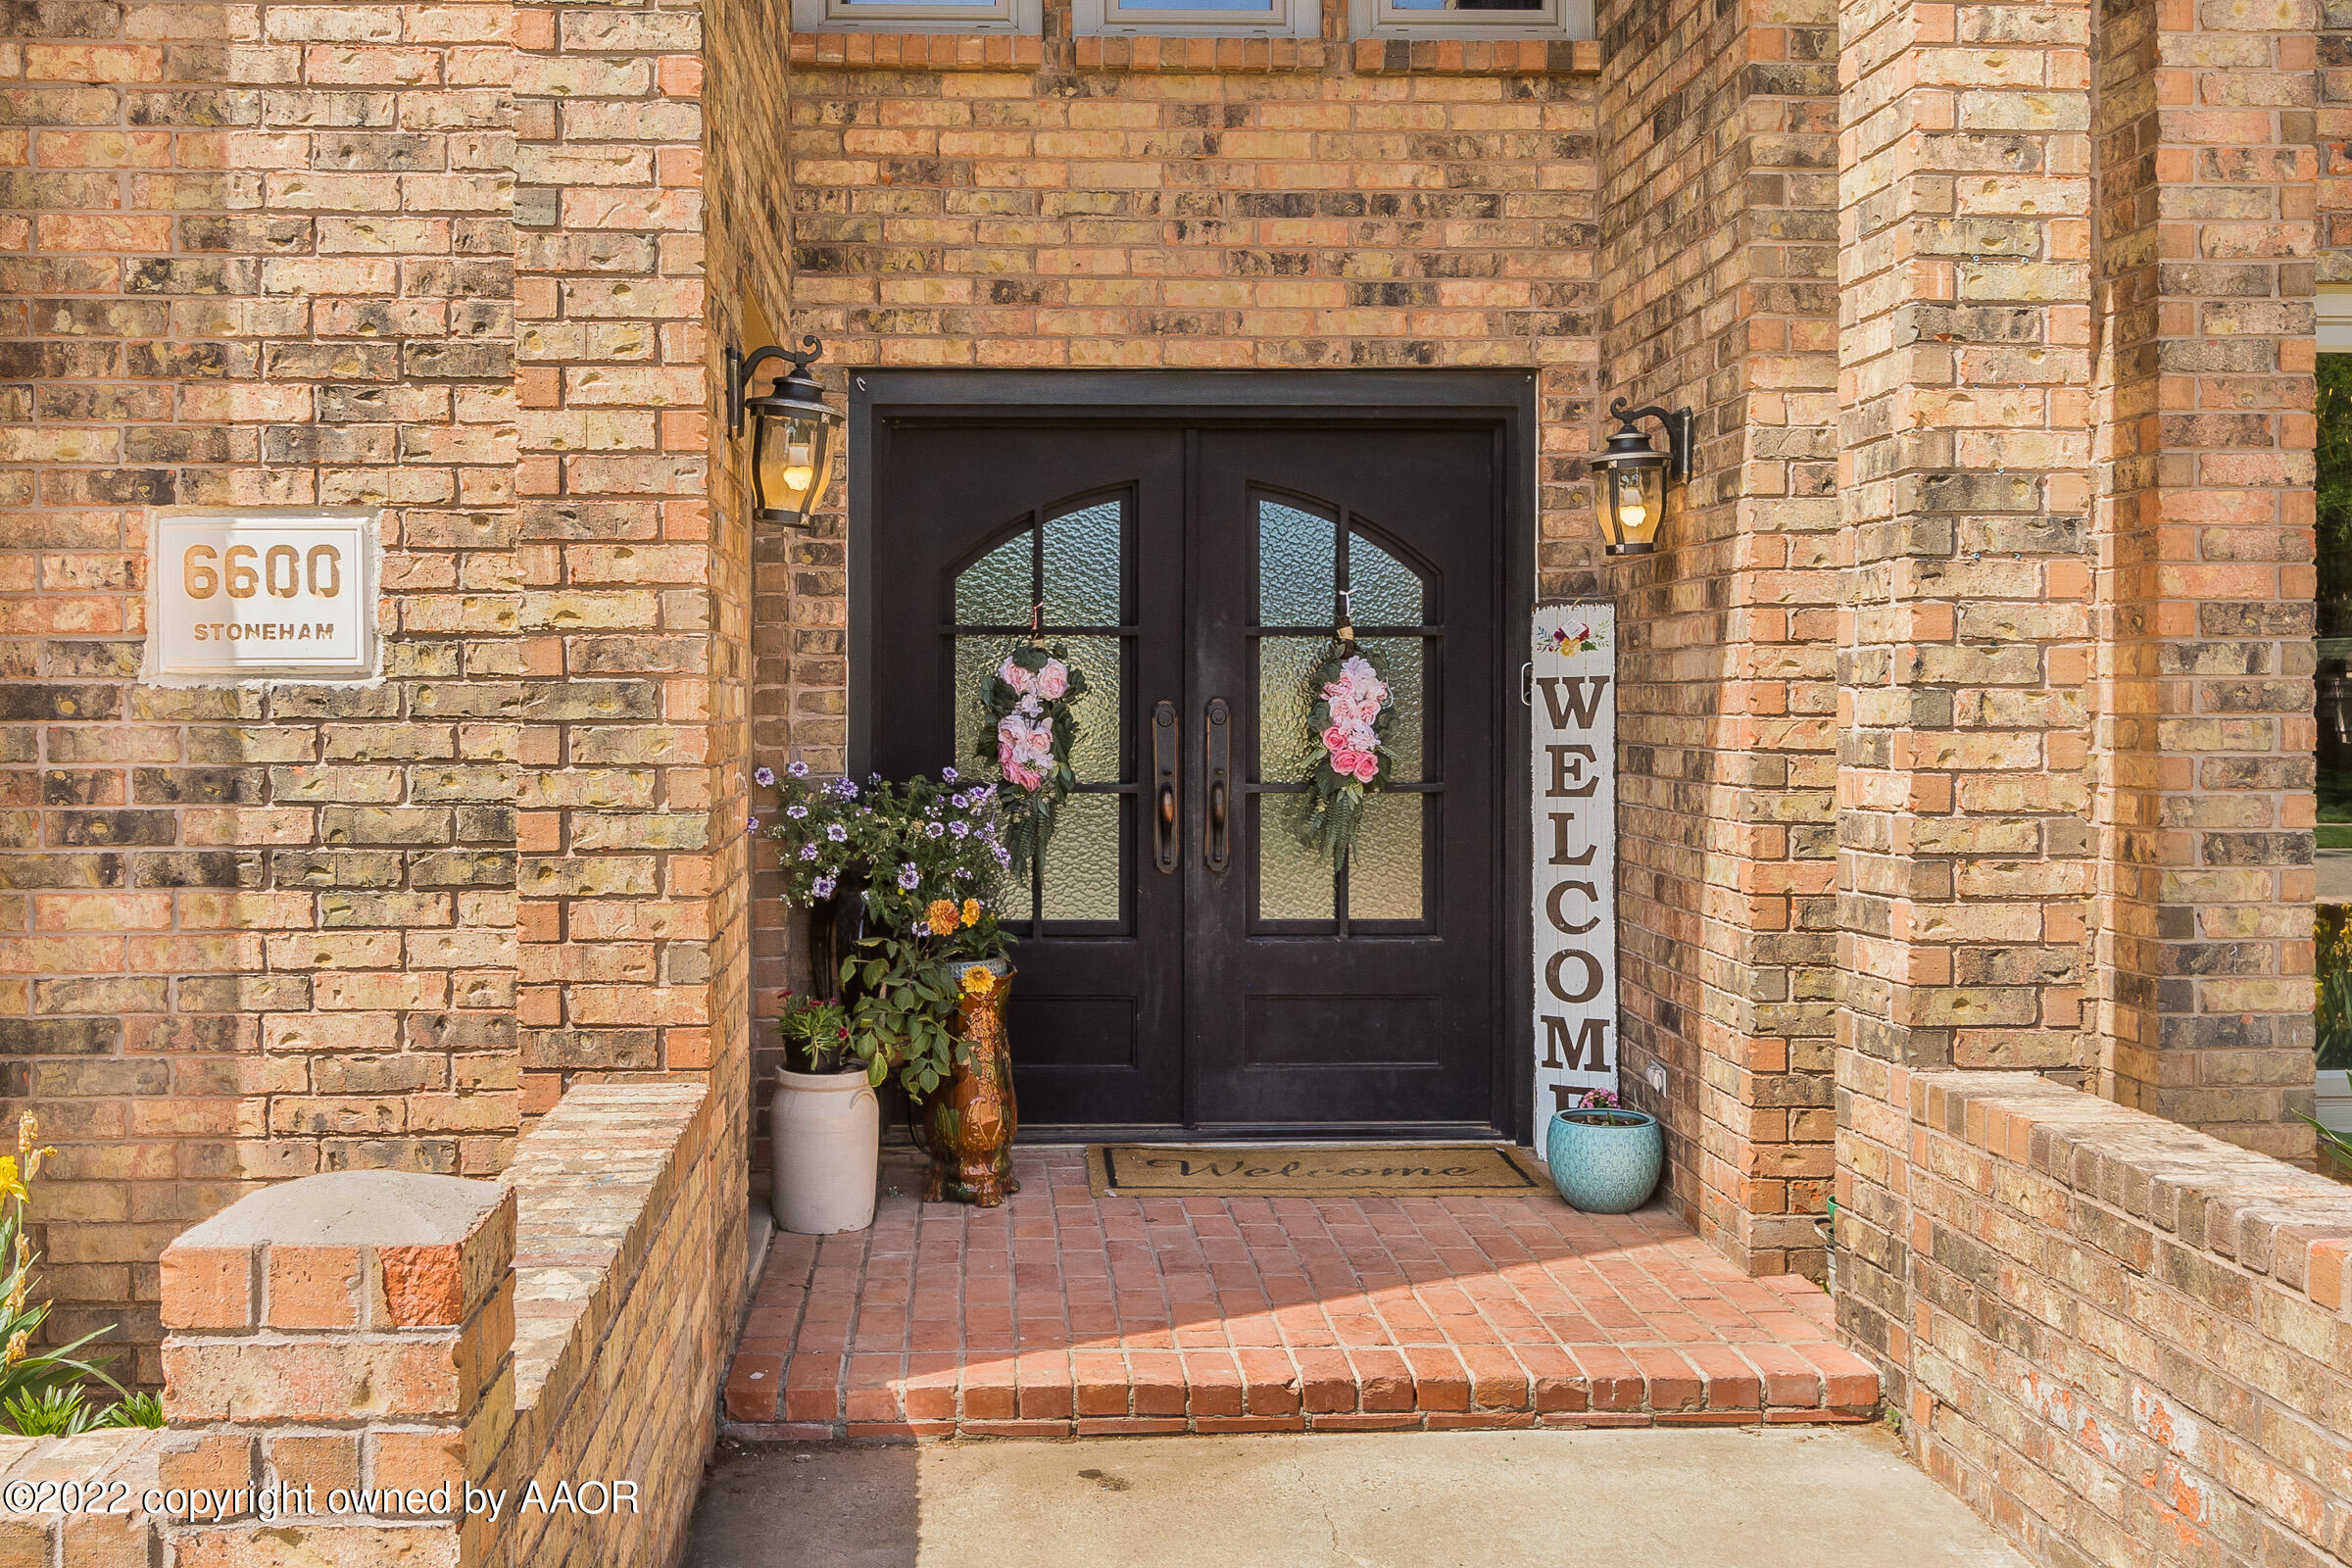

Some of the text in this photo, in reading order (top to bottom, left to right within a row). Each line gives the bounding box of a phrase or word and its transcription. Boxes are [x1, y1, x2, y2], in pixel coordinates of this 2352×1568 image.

[183, 544, 341, 600] 6600
[194, 623, 334, 641] STONEHAM
[1147, 1158, 1481, 1177] Welcome
